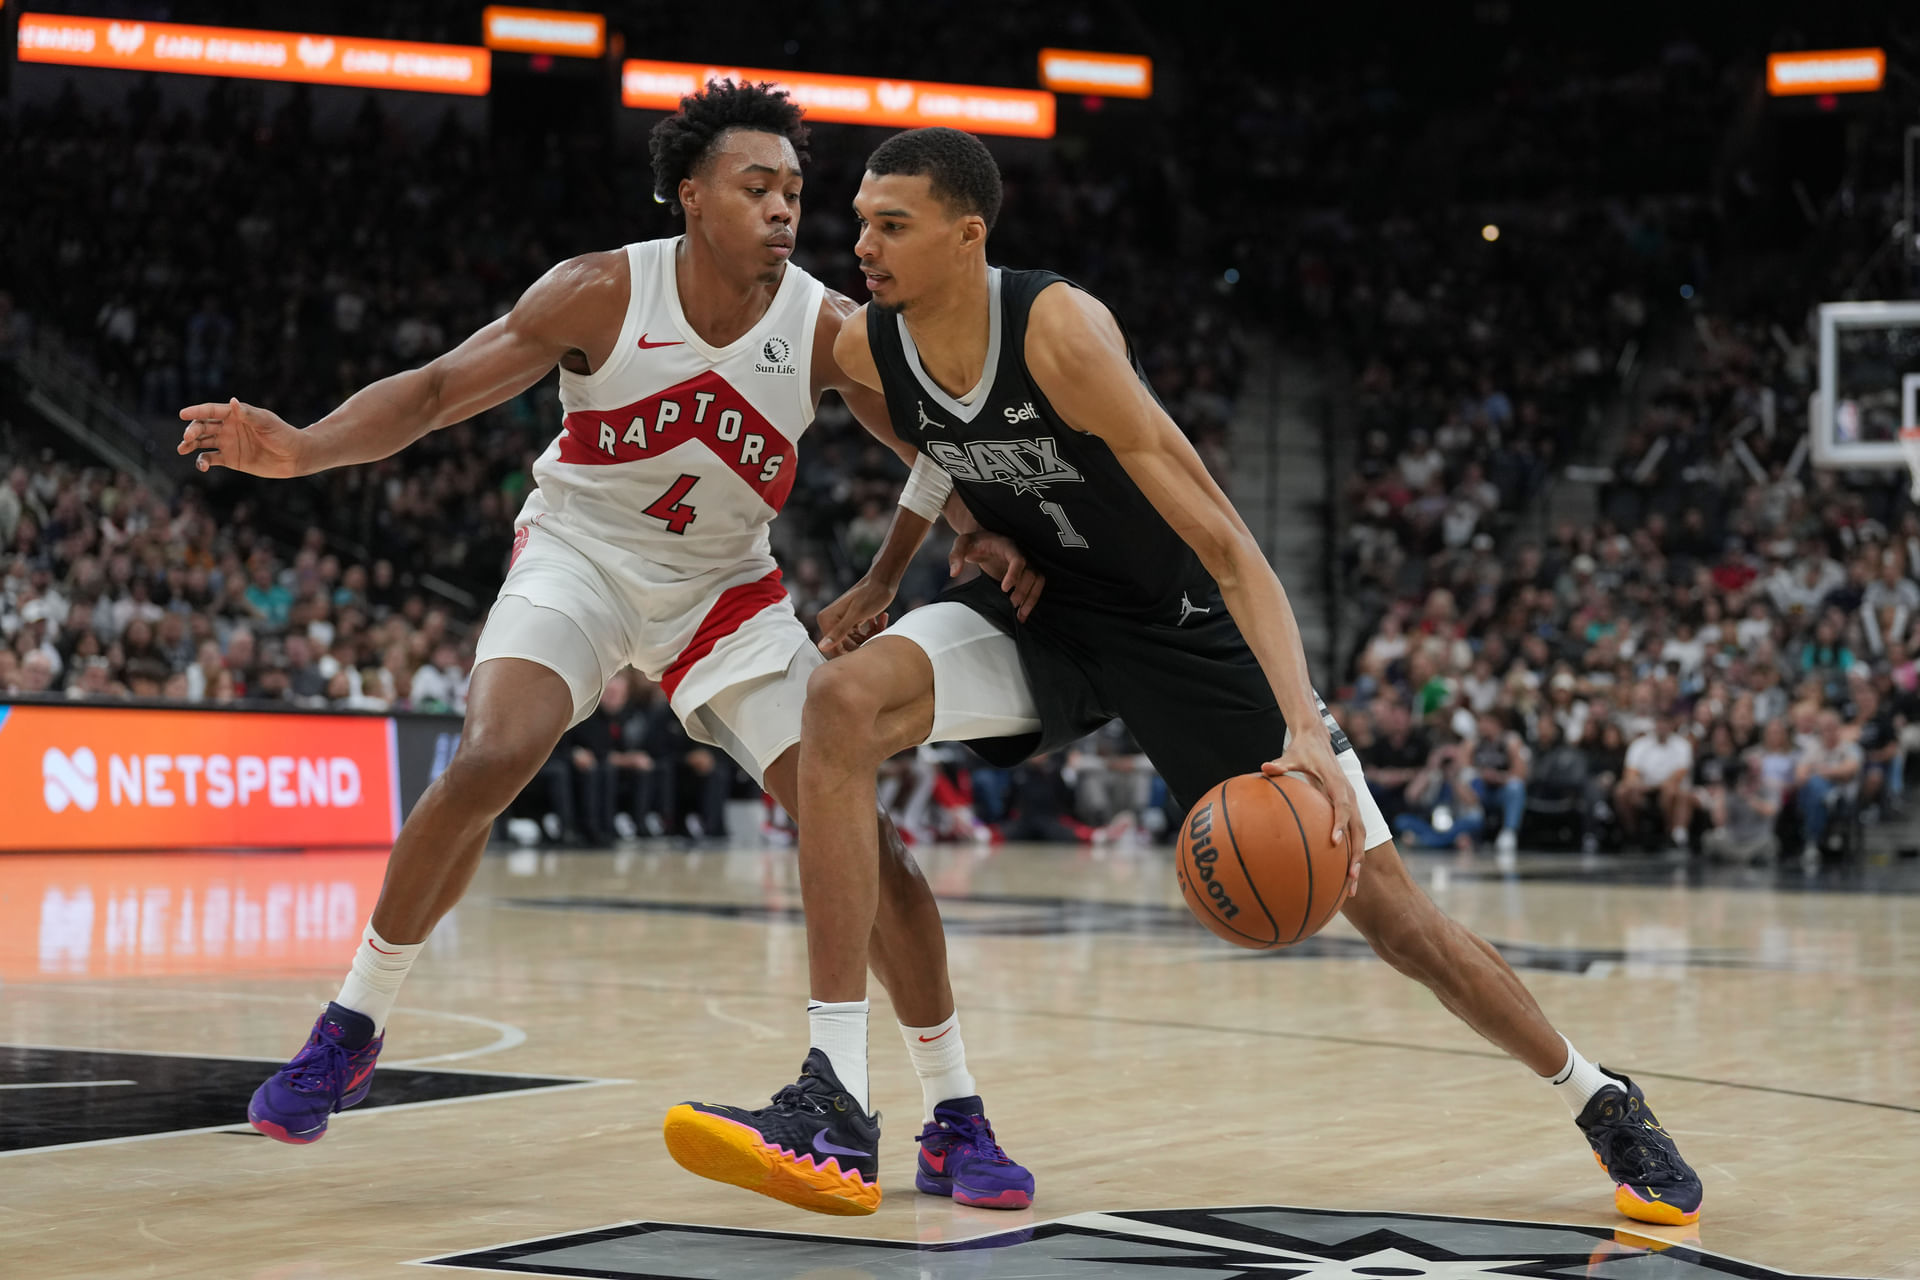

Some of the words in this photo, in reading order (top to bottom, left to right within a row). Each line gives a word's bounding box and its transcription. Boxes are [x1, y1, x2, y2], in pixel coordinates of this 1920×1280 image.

[755, 363, 775, 373] Sun
[777, 364, 796, 375] Life
[598, 391, 784, 483] RAPTORS
[641, 473, 701, 536] 4
[1039, 500, 1089, 549] 1
[108, 753, 362, 808] NETSPEND
[1189, 802, 1241, 921] Wilson
